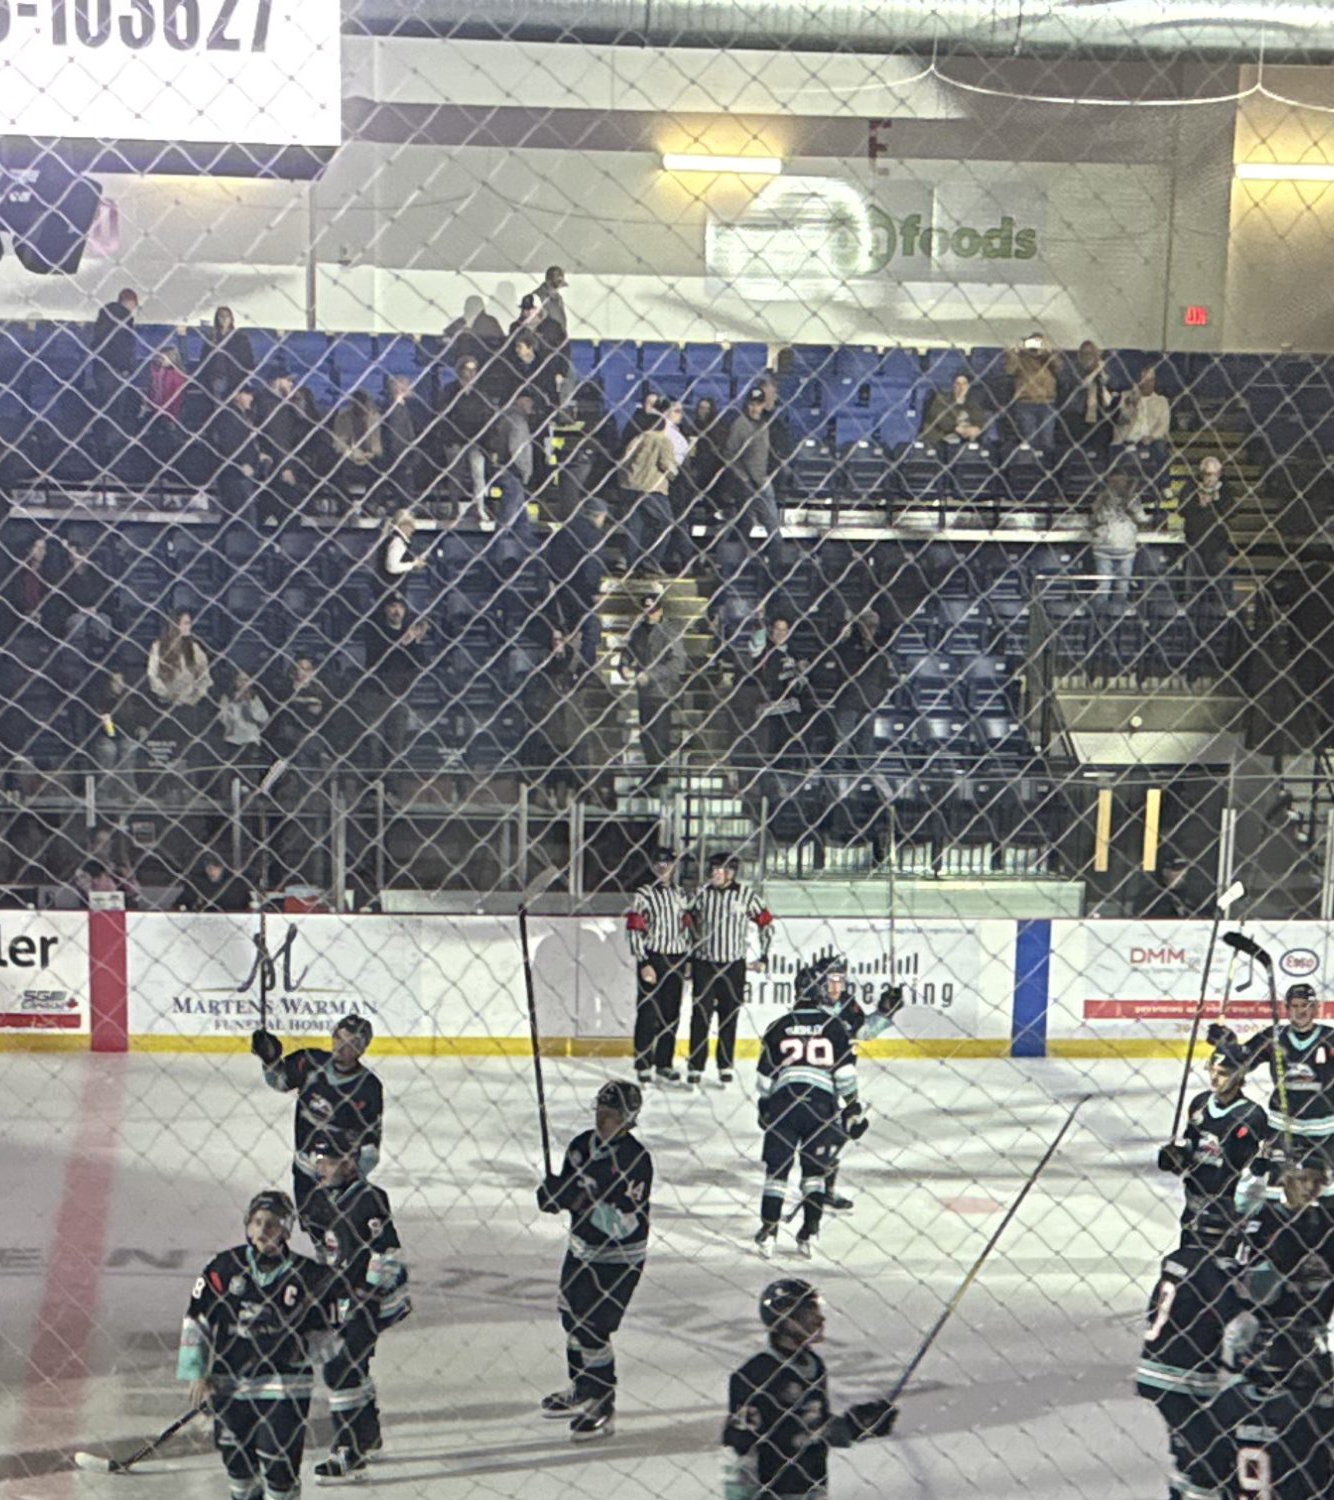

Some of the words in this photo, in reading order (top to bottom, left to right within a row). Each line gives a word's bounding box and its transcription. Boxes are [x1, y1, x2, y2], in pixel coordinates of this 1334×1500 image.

[900, 213, 1038, 260] foods
[1130, 947, 1185, 965] DMM
[213, 1018, 283, 1032] FUNEAL
